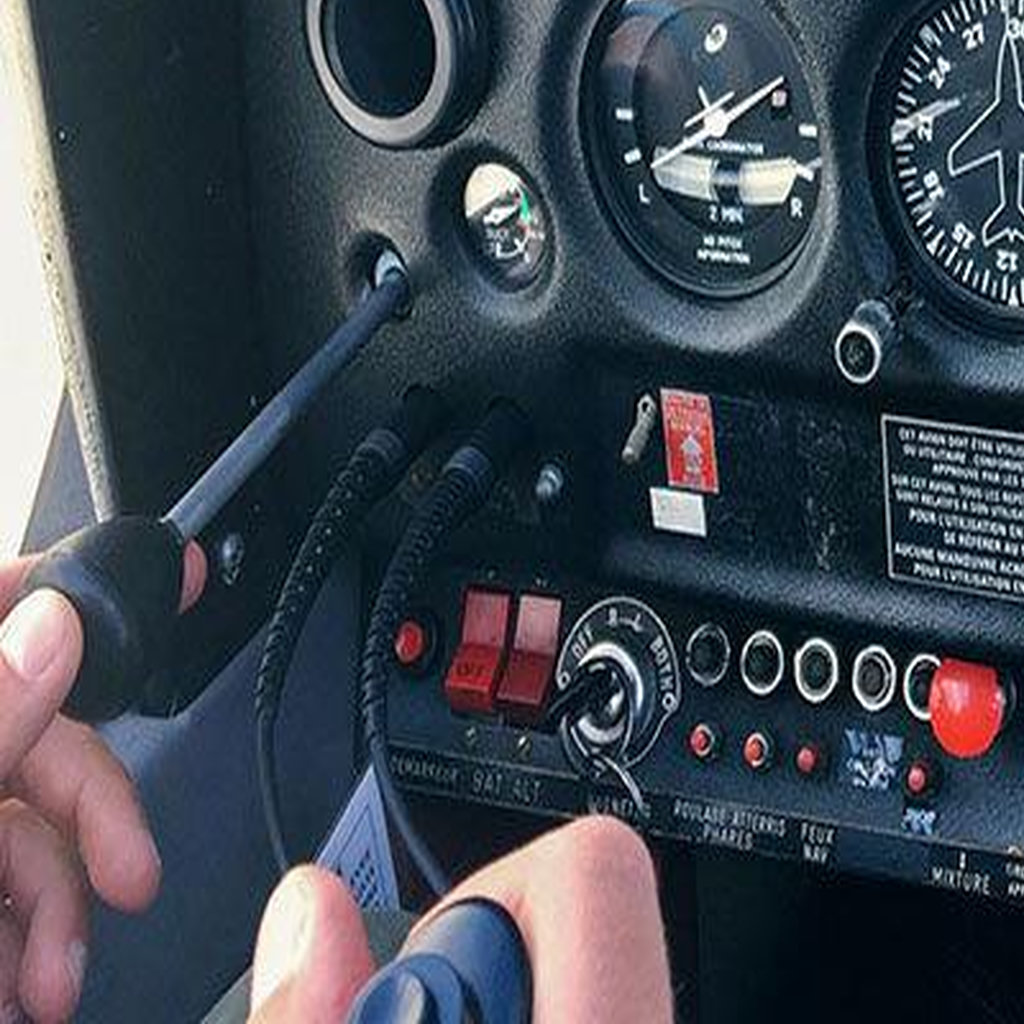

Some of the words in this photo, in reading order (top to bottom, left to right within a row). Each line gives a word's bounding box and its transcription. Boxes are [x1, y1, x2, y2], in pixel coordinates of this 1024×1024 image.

[961, 21, 985, 50] 27
[929, 56, 951, 89] 24
[639, 184, 650, 204] L
[790, 197, 803, 218] R
[649, 635, 675, 691] BOTH
